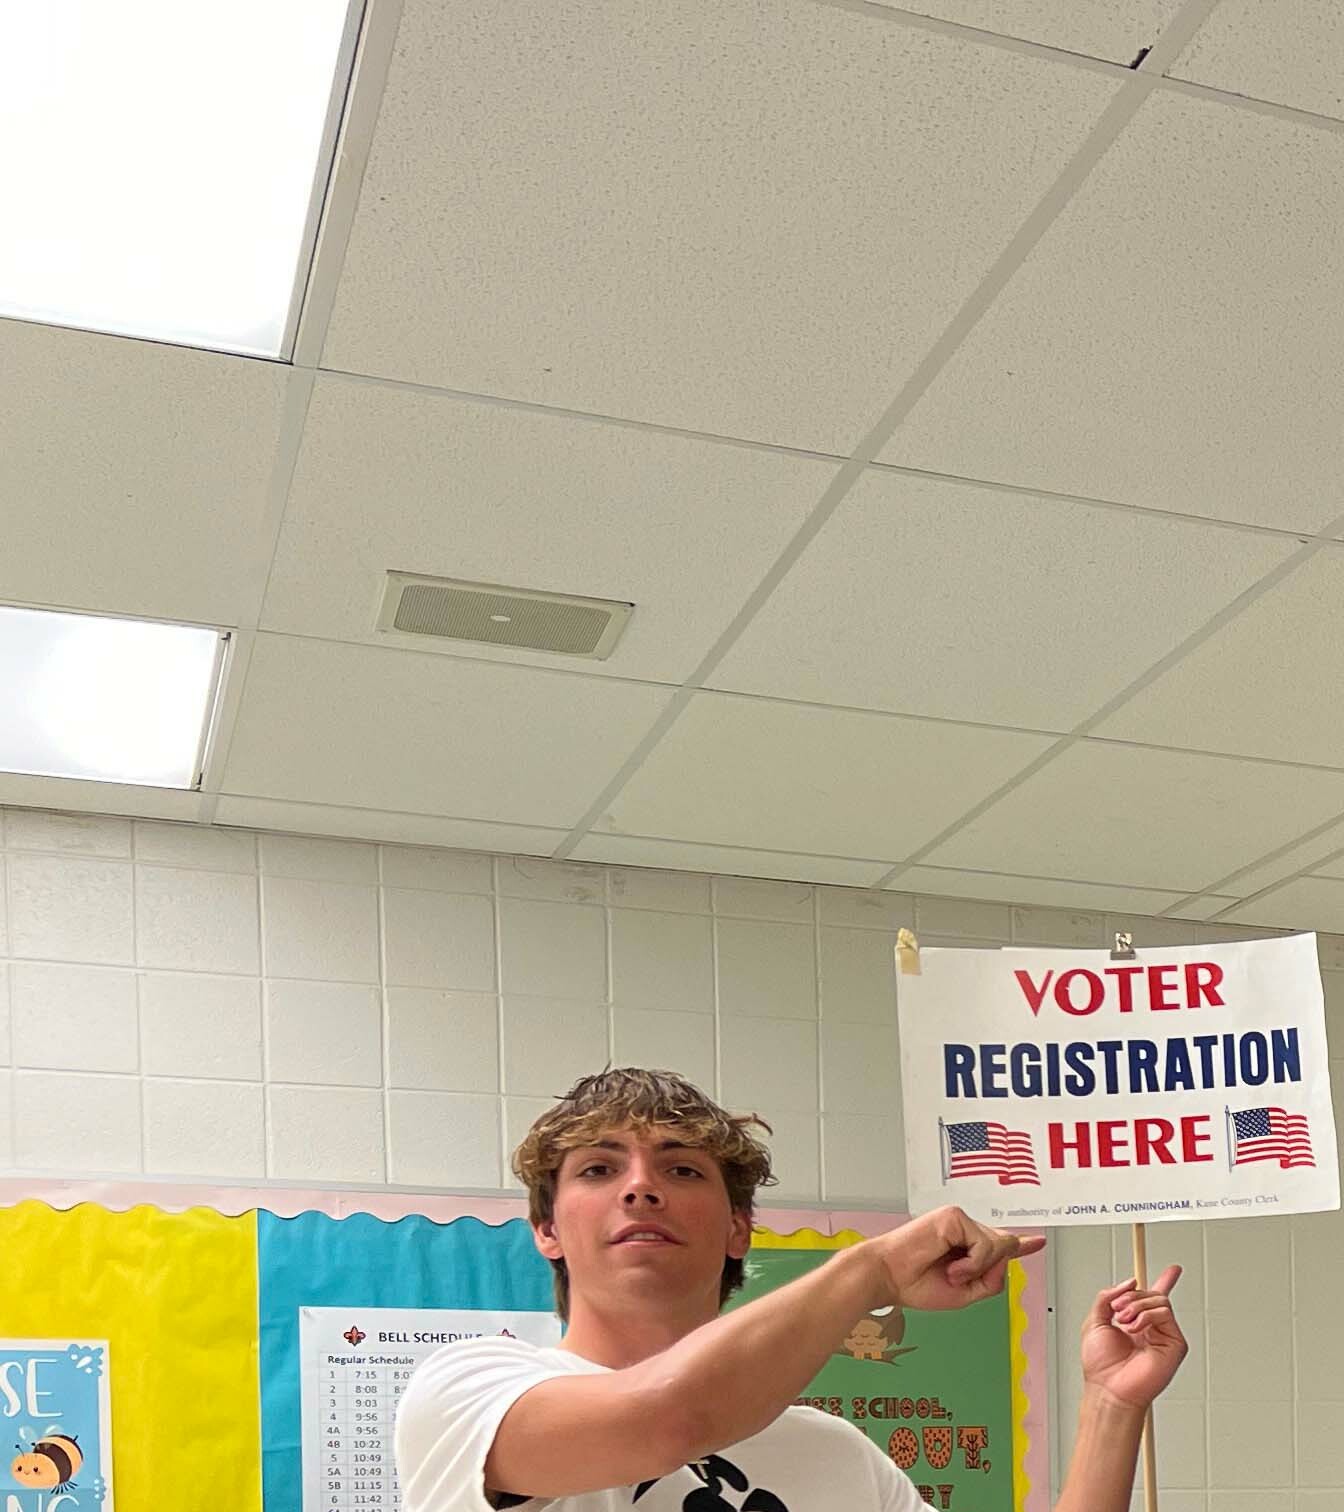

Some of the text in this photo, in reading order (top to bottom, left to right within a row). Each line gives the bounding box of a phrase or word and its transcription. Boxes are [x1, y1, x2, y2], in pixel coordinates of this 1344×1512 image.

[1014, 962, 1225, 1017] VOTER
[943, 1027, 1301, 1098] REGISTRATION
[1048, 1115, 1214, 1169] HERE
[1065, 1205, 1096, 1215] JOHN
[1114, 1200, 1193, 1213] CUNNINGHAM,
[379, 1332, 410, 1343] BELL
[327, 1355, 415, 1367] Regular Schedule
[330, 1370, 335, 1380] 1
[330, 1385, 336, 1394] 2
[330, 1399, 336, 1408] 3
[852, 1397, 953, 1421] SCHOOL,
[330, 1412, 337, 1421] 4
[327, 1426, 340, 1435] 4A
[327, 1440, 340, 1449] 4B
[887, 1426, 991, 1474] OUT,
[331, 1453, 337, 1462] 5
[328, 1467, 341, 1476] 5A
[328, 1481, 341, 1490] 5B
[331, 1495, 337, 1504] 6
